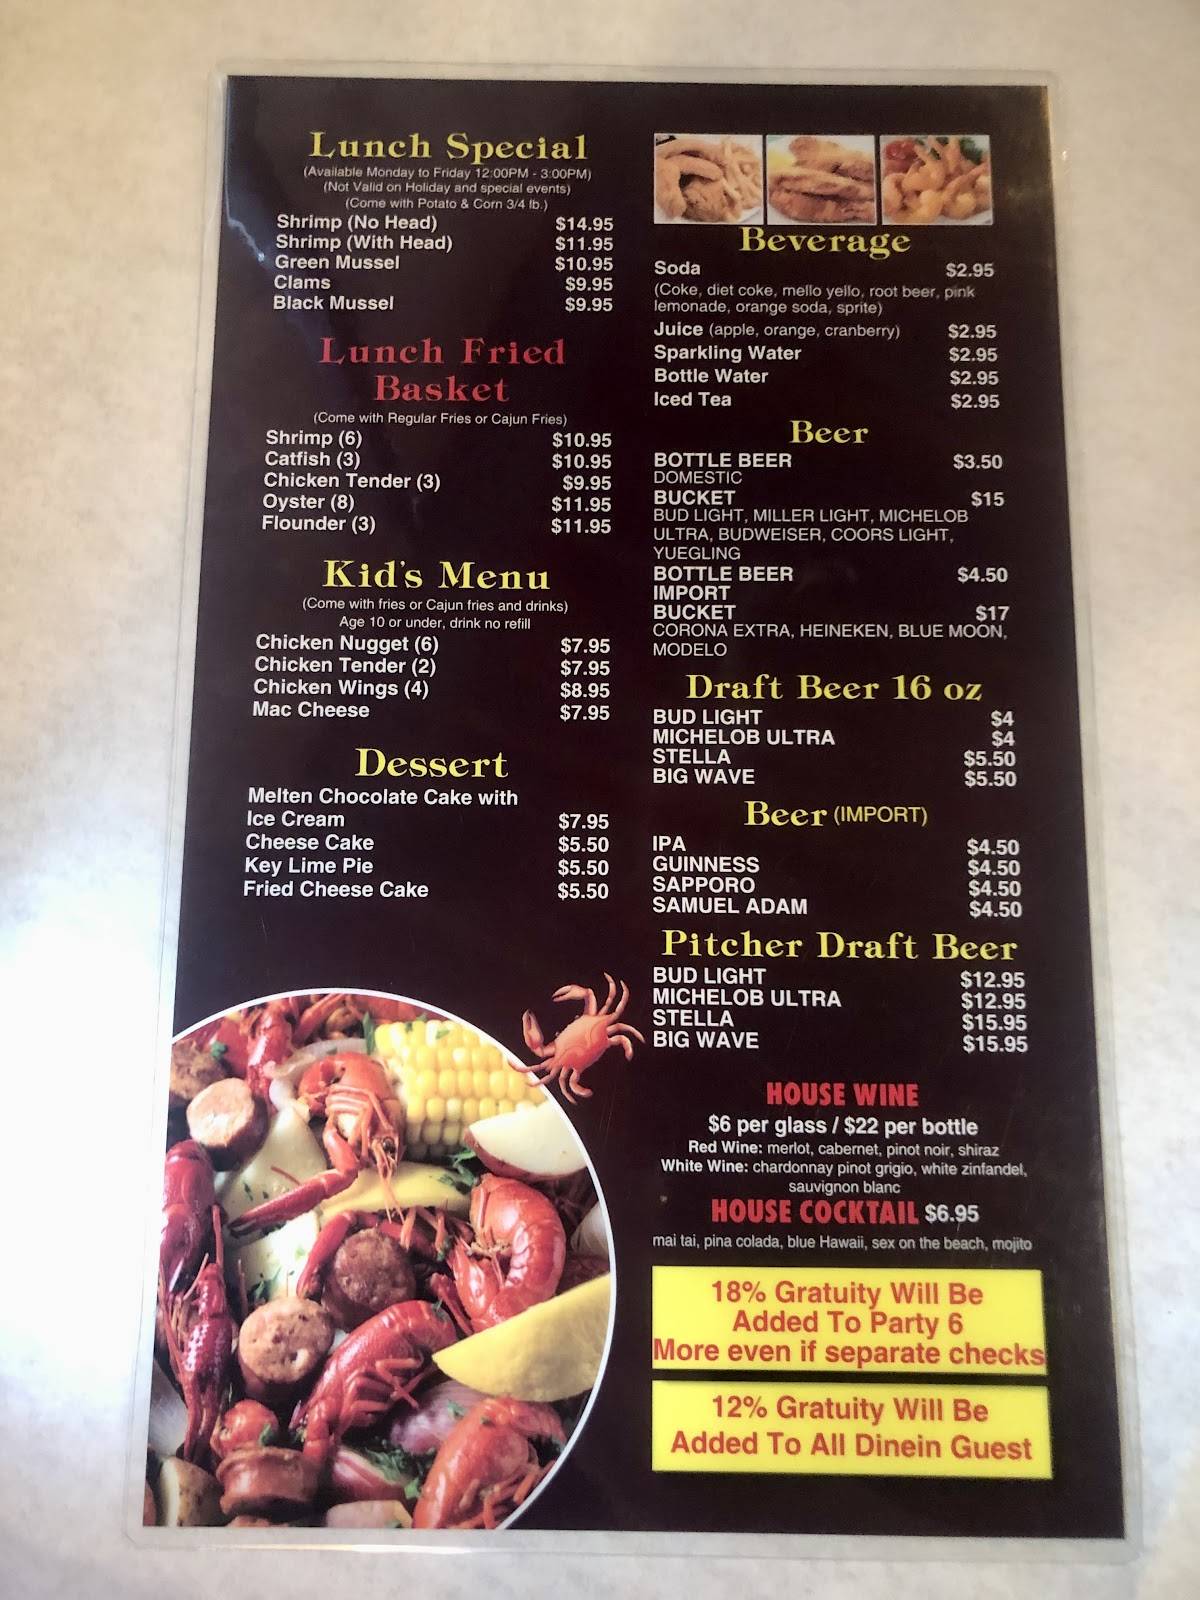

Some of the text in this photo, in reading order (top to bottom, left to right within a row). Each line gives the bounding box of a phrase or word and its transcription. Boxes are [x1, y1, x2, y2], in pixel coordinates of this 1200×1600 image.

[308, 131, 586, 165] Lunch Special
[303, 165, 363, 178] (Available
[366, 165, 415, 180] Monday
[417, 167, 429, 178] to
[433, 167, 471, 180] Friday
[475, 167, 528, 178] 12:00PM
[540, 168, 591, 181] 3:00PM)
[323, 180, 570, 196] (Not Valid on Holiday and special events)
[277, 213, 437, 233] Shrimp (No Head)
[555, 216, 613, 232] $14.95
[739, 226, 910, 259] Beverage
[274, 254, 399, 269] Green Mussel
[554, 255, 613, 272] $10.95
[654, 260, 700, 275] Soda
[945, 262, 994, 277] $2.95
[273, 294, 394, 310] Black Mussel
[565, 296, 612, 312] $9.95
[654, 299, 882, 316] lemonade, orange soda, sprite)
[653, 321, 900, 340] Juice (apple, orange, cranberry)
[948, 323, 996, 339] $2.95
[318, 336, 563, 364] Lunch Fried
[654, 367, 768, 383] Bottle Water
[950, 370, 999, 386] $2.95
[374, 374, 506, 401] Basket
[313, 411, 567, 427] (Come with Regular Fries or Cajun Fries)
[265, 429, 362, 449] Shrimp (6)
[552, 431, 611, 448] $10.95
[790, 420, 868, 443] Beer
[654, 452, 791, 467] BOTTLE BEER
[953, 453, 1002, 470] $3.50
[263, 471, 440, 492] Chicken Tender (3)
[562, 474, 611, 491] $9.95
[653, 470, 742, 484] DOMESTIC
[261, 514, 375, 534] Flounder (3)
[653, 508, 968, 523] BUD LIGHT, MILLER LIGHT, MICHELOB
[551, 517, 611, 535] $11.95
[322, 559, 550, 589] Kid's Menu
[653, 584, 730, 600] IMPORT
[302, 596, 568, 614] (Come with fries or Cajun fries and drinks)
[653, 604, 736, 620] BUCKET
[975, 605, 1009, 622] $17
[255, 633, 438, 655] Chicken Nugget (6)
[560, 636, 610, 655] $7.95
[653, 642, 727, 656] MODELO
[253, 677, 428, 700] Chicken Wings (4)
[560, 681, 610, 699] $8.95
[685, 673, 982, 701] Draft Beer 16 oz
[653, 728, 835, 745] MICHELOB ULTRA
[991, 730, 1015, 748] $4
[354, 748, 508, 777] Dessert
[248, 786, 517, 805] Melten Chocolate Cake with
[246, 809, 344, 827] Ice Cream
[558, 812, 609, 831] $7.95
[743, 800, 927, 826] Beer (IMPORT)
[244, 856, 373, 877] Key Lime Pie
[557, 858, 609, 877] $5.50
[652, 855, 759, 873] GUINNESS
[968, 858, 1020, 877] $4.50
[652, 896, 807, 914] SAMUEL ADAM
[969, 899, 1022, 918] $4.50
[661, 929, 1017, 960] Pitcher Draft Beer
[653, 987, 841, 1007] MICHELOB ULTRA
[961, 991, 1026, 1010] $12.95
[766, 1081, 918, 1106] HOUSE WINE
[688, 1139, 999, 1158] Red Wine: merlot, cabernet, pinot noir, shiraz
[711, 1198, 979, 1224] HOUSE COCKTAIL $6.95
[712, 1280, 983, 1311] 18% Gratuity Will Be
[732, 1309, 963, 1340] Added To Party 6
[671, 1430, 1032, 1460] Added To All Dinein Guest
